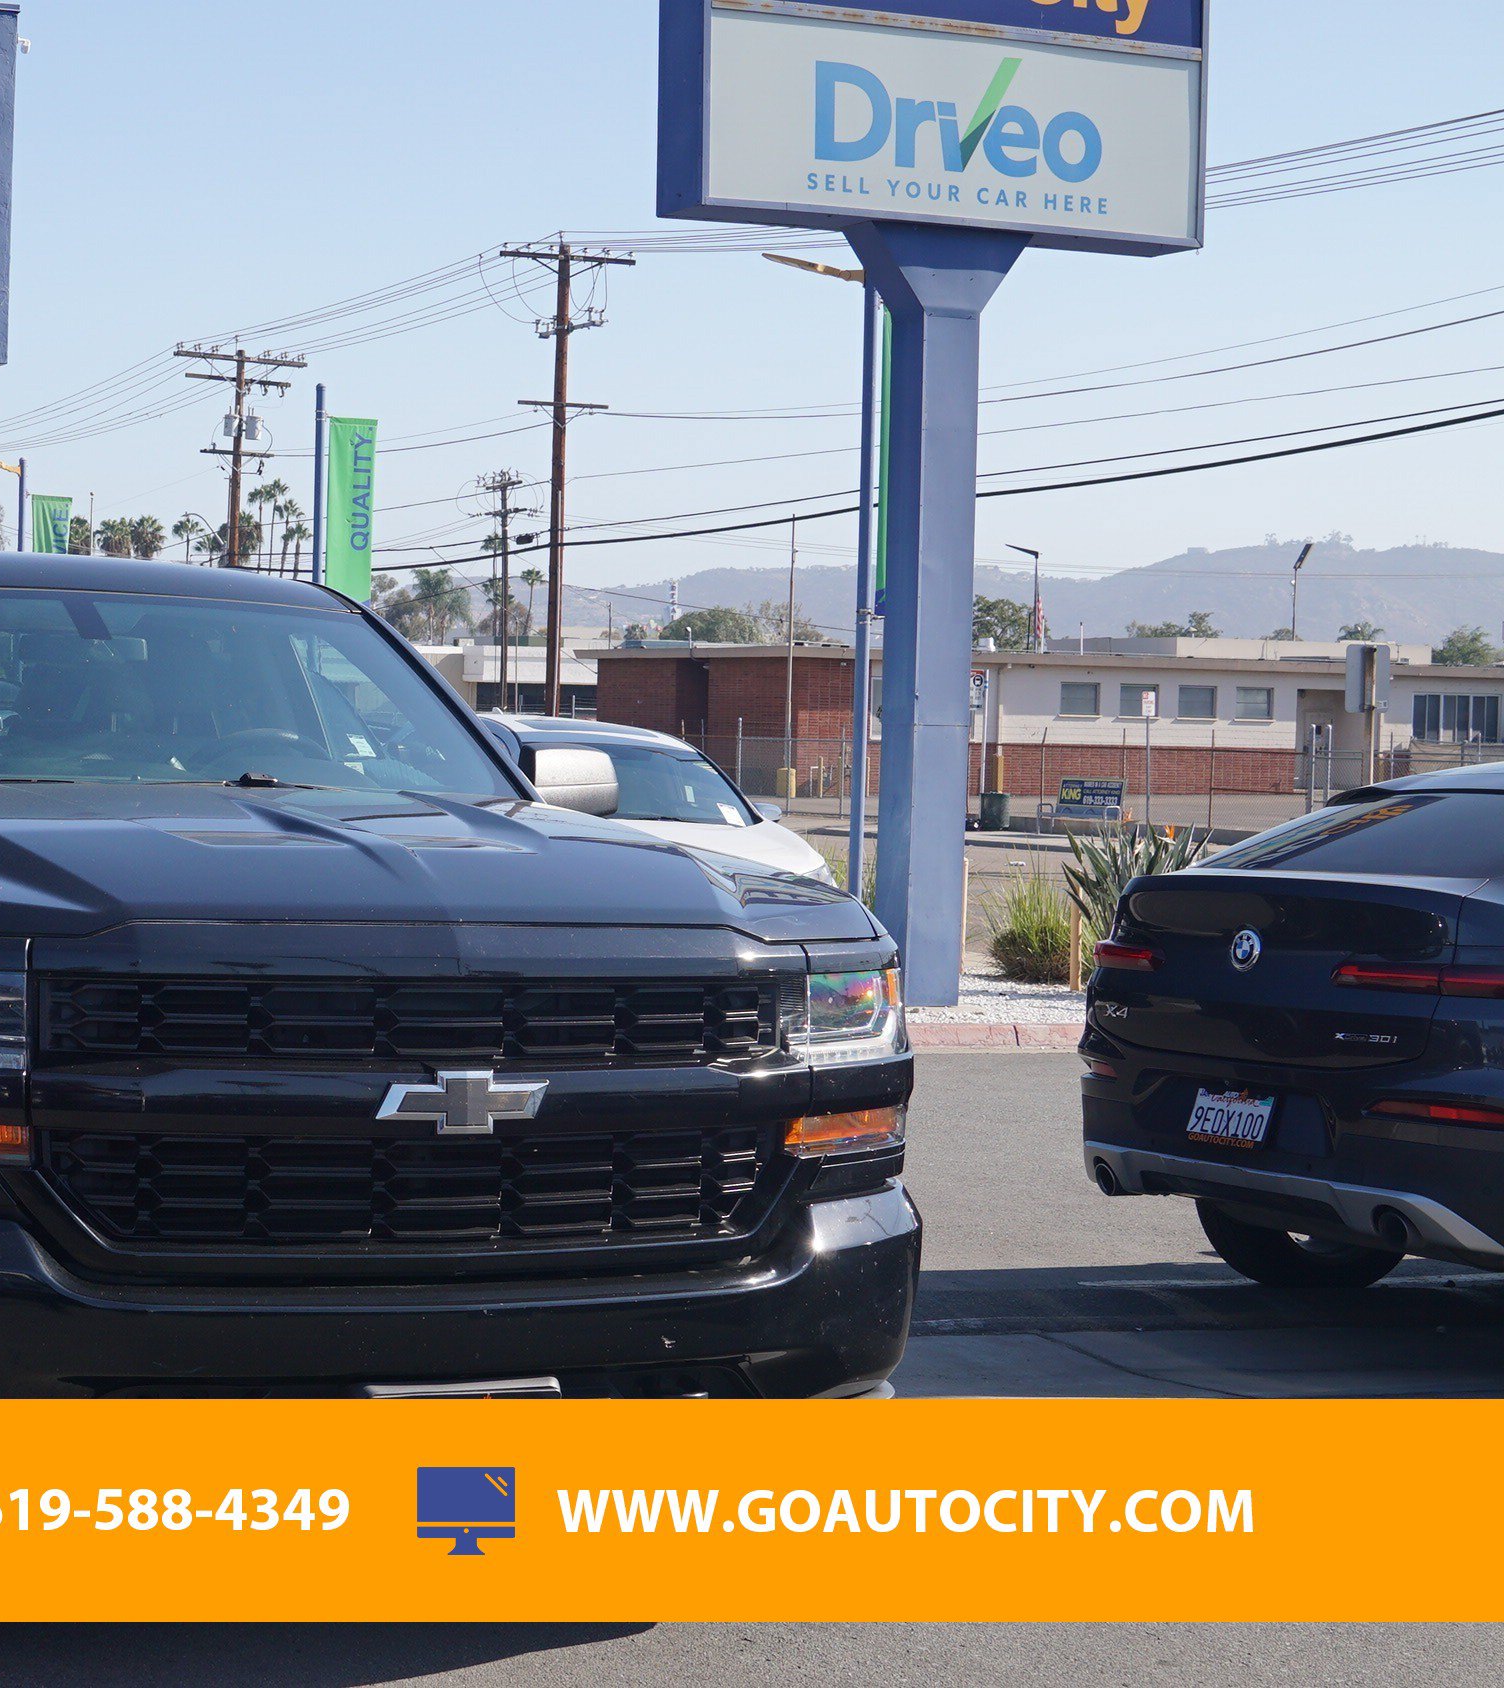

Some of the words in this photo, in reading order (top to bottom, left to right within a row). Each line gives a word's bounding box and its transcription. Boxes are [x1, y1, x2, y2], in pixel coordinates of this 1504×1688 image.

[814, 56, 1103, 184] Driveo
[806, 172, 870, 195] SELL
[887, 179, 960, 202] YOUR
[976, 187, 1027, 208] CAR
[1043, 193, 1108, 215] HERE
[1061, 788, 1082, 800] KING
[1105, 1004, 1128, 1018] X4
[1188, 1132, 1254, 1148] GOAUTOCITY.COM
